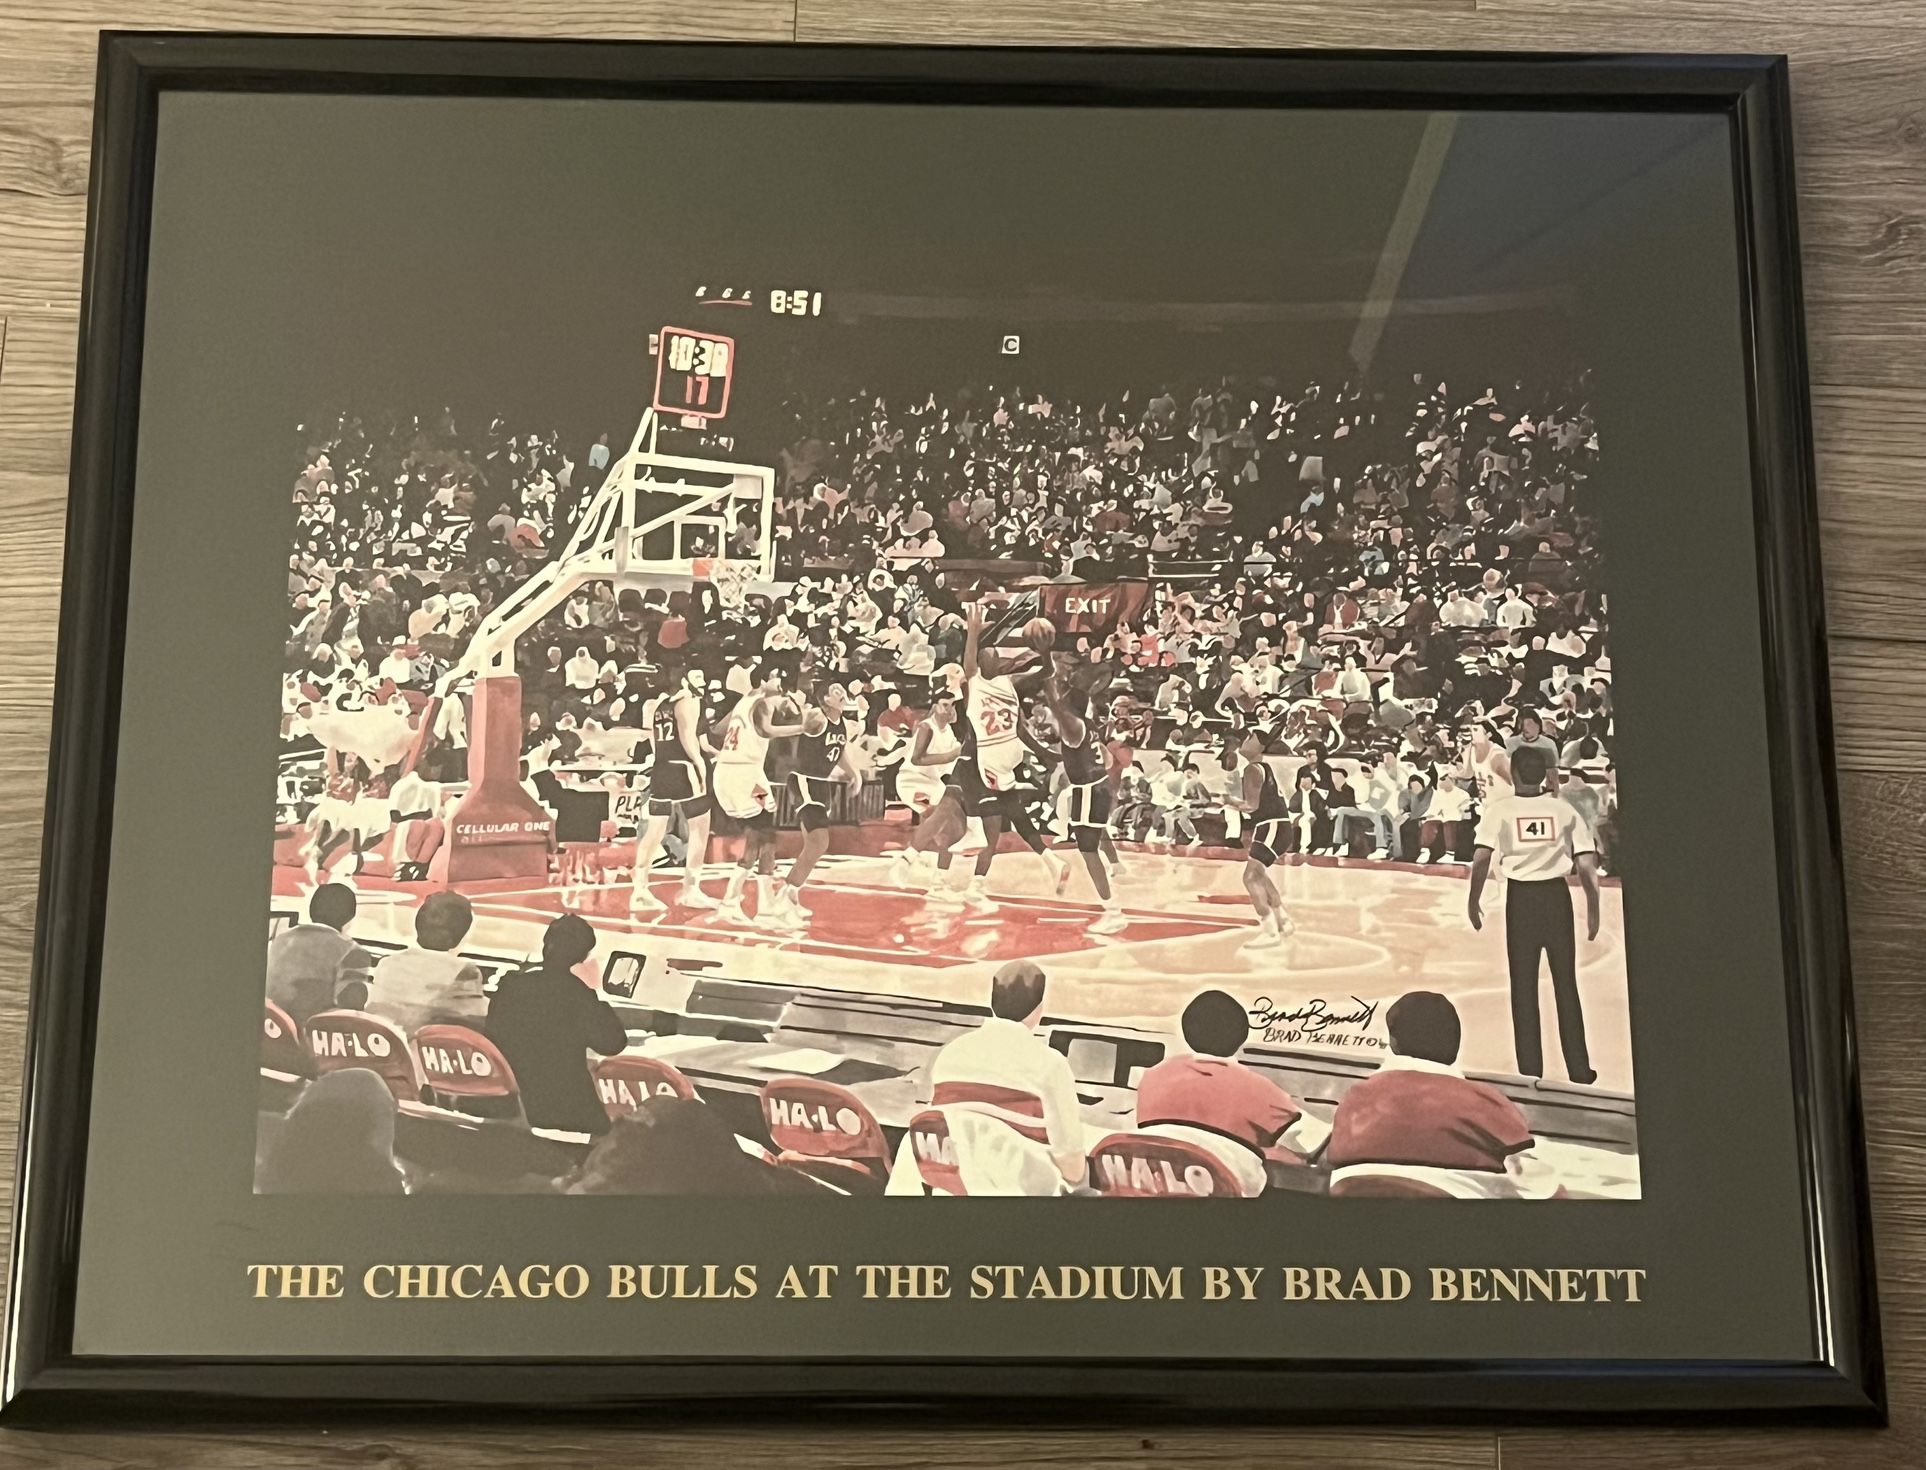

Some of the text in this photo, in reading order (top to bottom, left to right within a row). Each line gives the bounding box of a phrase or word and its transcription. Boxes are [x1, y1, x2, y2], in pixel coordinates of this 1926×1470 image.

[770, 290, 822, 316] 8:51
[1065, 597, 1111, 614] EXIT
[655, 721, 675, 741] 12
[981, 708, 1014, 736] 23
[456, 821, 550, 834] CELLULAR ONE
[1526, 822, 1545, 836] 41
[247, 1264, 1647, 1302] THE CHICAGO BULLS AT THE STADIUM BY BRAD BENNETT
